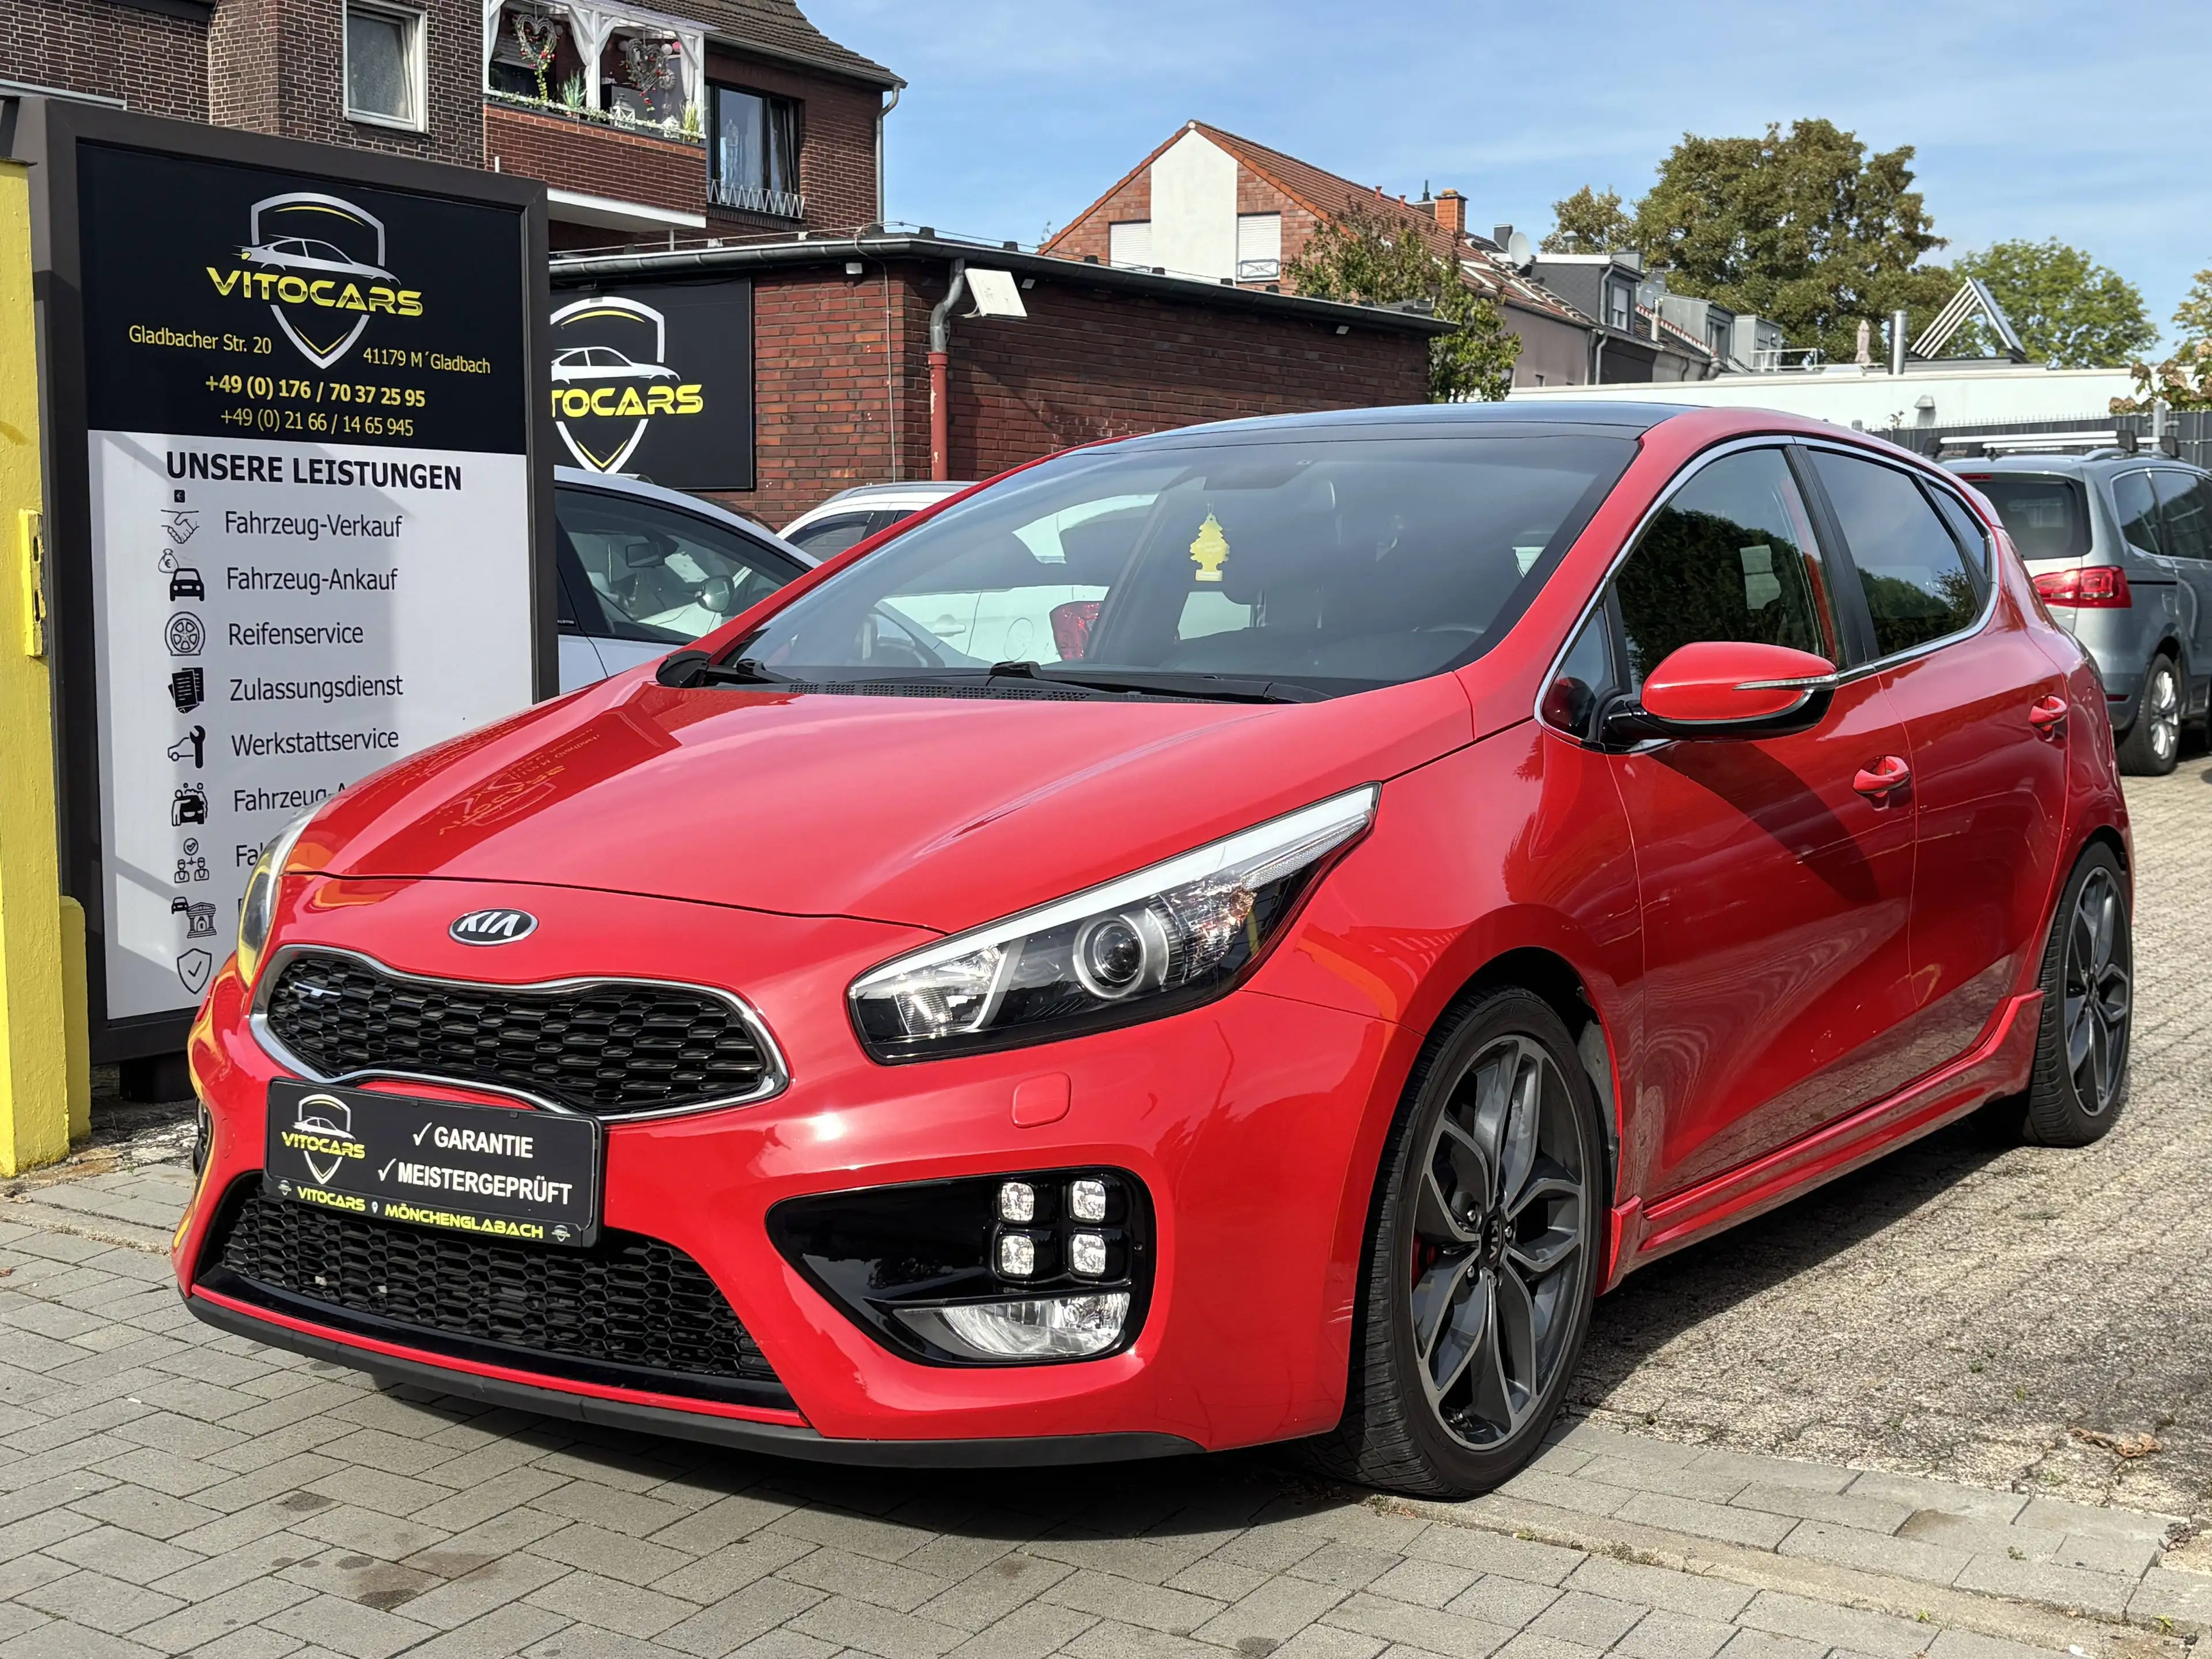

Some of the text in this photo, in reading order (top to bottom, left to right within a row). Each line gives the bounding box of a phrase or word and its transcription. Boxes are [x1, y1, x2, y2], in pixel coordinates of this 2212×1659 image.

[206, 267, 423, 317] VITOCARS
[128, 325, 272, 354] Gladbacher Str. 20
[363, 347, 406, 366] 41179
[205, 374, 426, 407] +49 (0) 176 / 70 37 25 95
[221, 408, 414, 437] +49 (0) 21 66 / 14 65 945
[166, 451, 461, 490] UNSERE LEISTUNGEN
[225, 510, 403, 541] Fahrzeug-Verkauf
[227, 566, 398, 596] Fahrzeug-Ankauf
[229, 622, 363, 646] Reifenservice
[230, 675, 404, 703] Zulassungsdienst
[231, 730, 399, 757] Werkstattservice
[457, 912, 520, 937] KIA
[281, 1131, 366, 1159] VITOCARS
[434, 1126, 533, 1158] GARANTIE
[397, 1162, 573, 1205] MEISTERGEPRÜFT
[297, 1185, 544, 1239] VITOCARS MÖNCHENGLABACH
